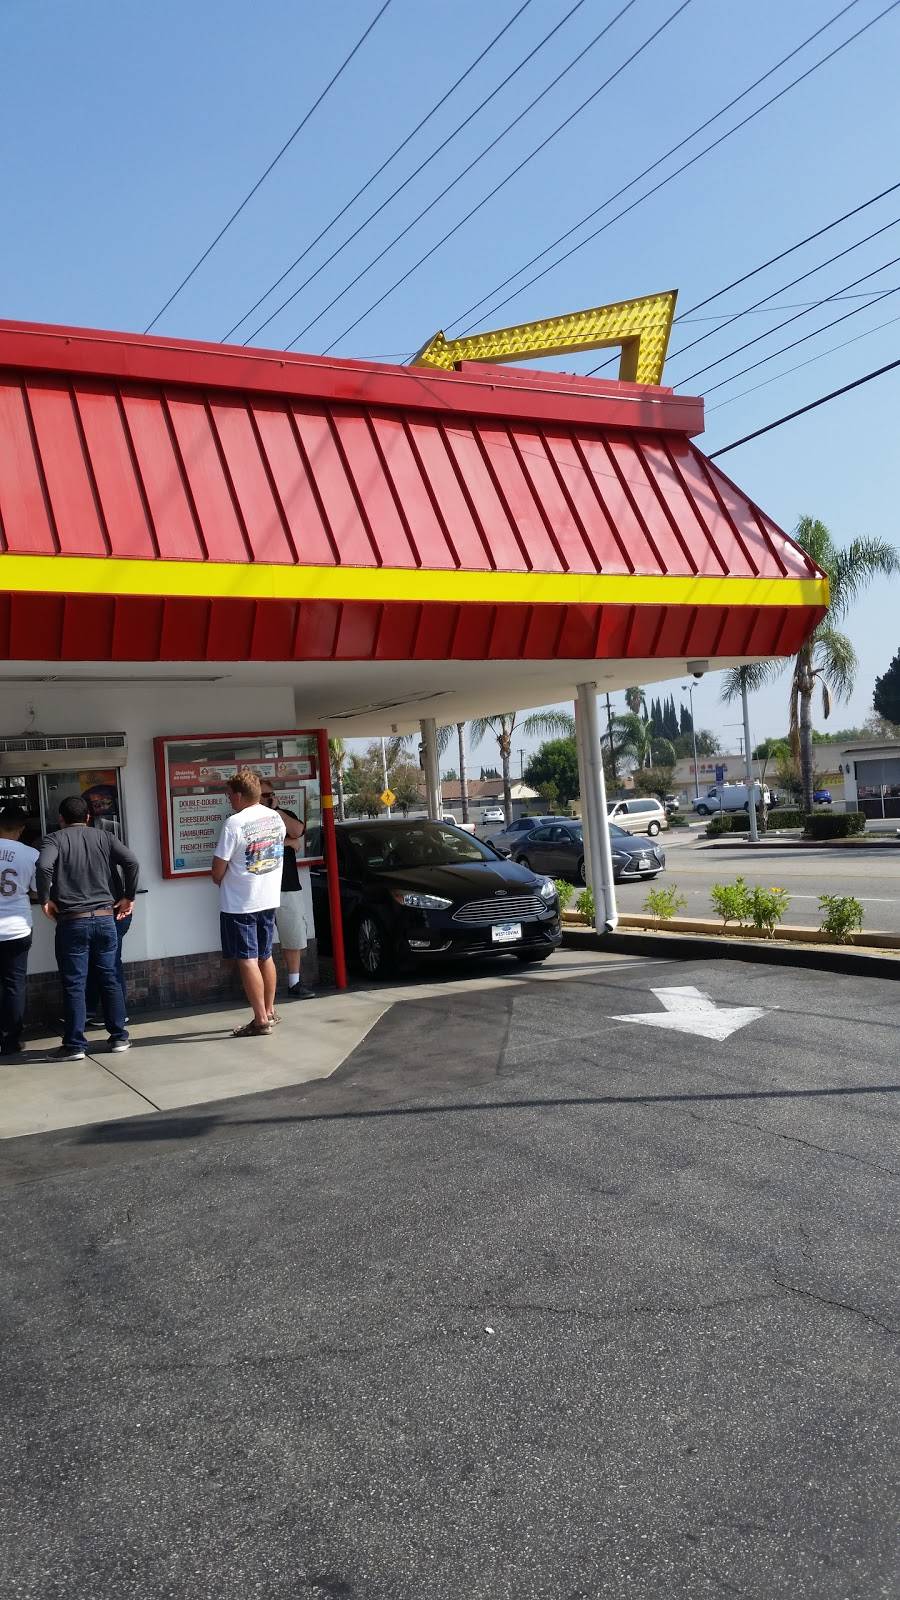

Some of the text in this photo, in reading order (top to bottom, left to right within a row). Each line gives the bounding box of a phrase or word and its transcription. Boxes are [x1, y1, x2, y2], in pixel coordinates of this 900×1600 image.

[179, 798, 223, 808] DOUBLE-DOUBLE
[179, 814, 222, 824] CHEESEBURGER
[179, 828, 215, 838] HAMBURGER
[180, 843, 202, 851] FRENCH
